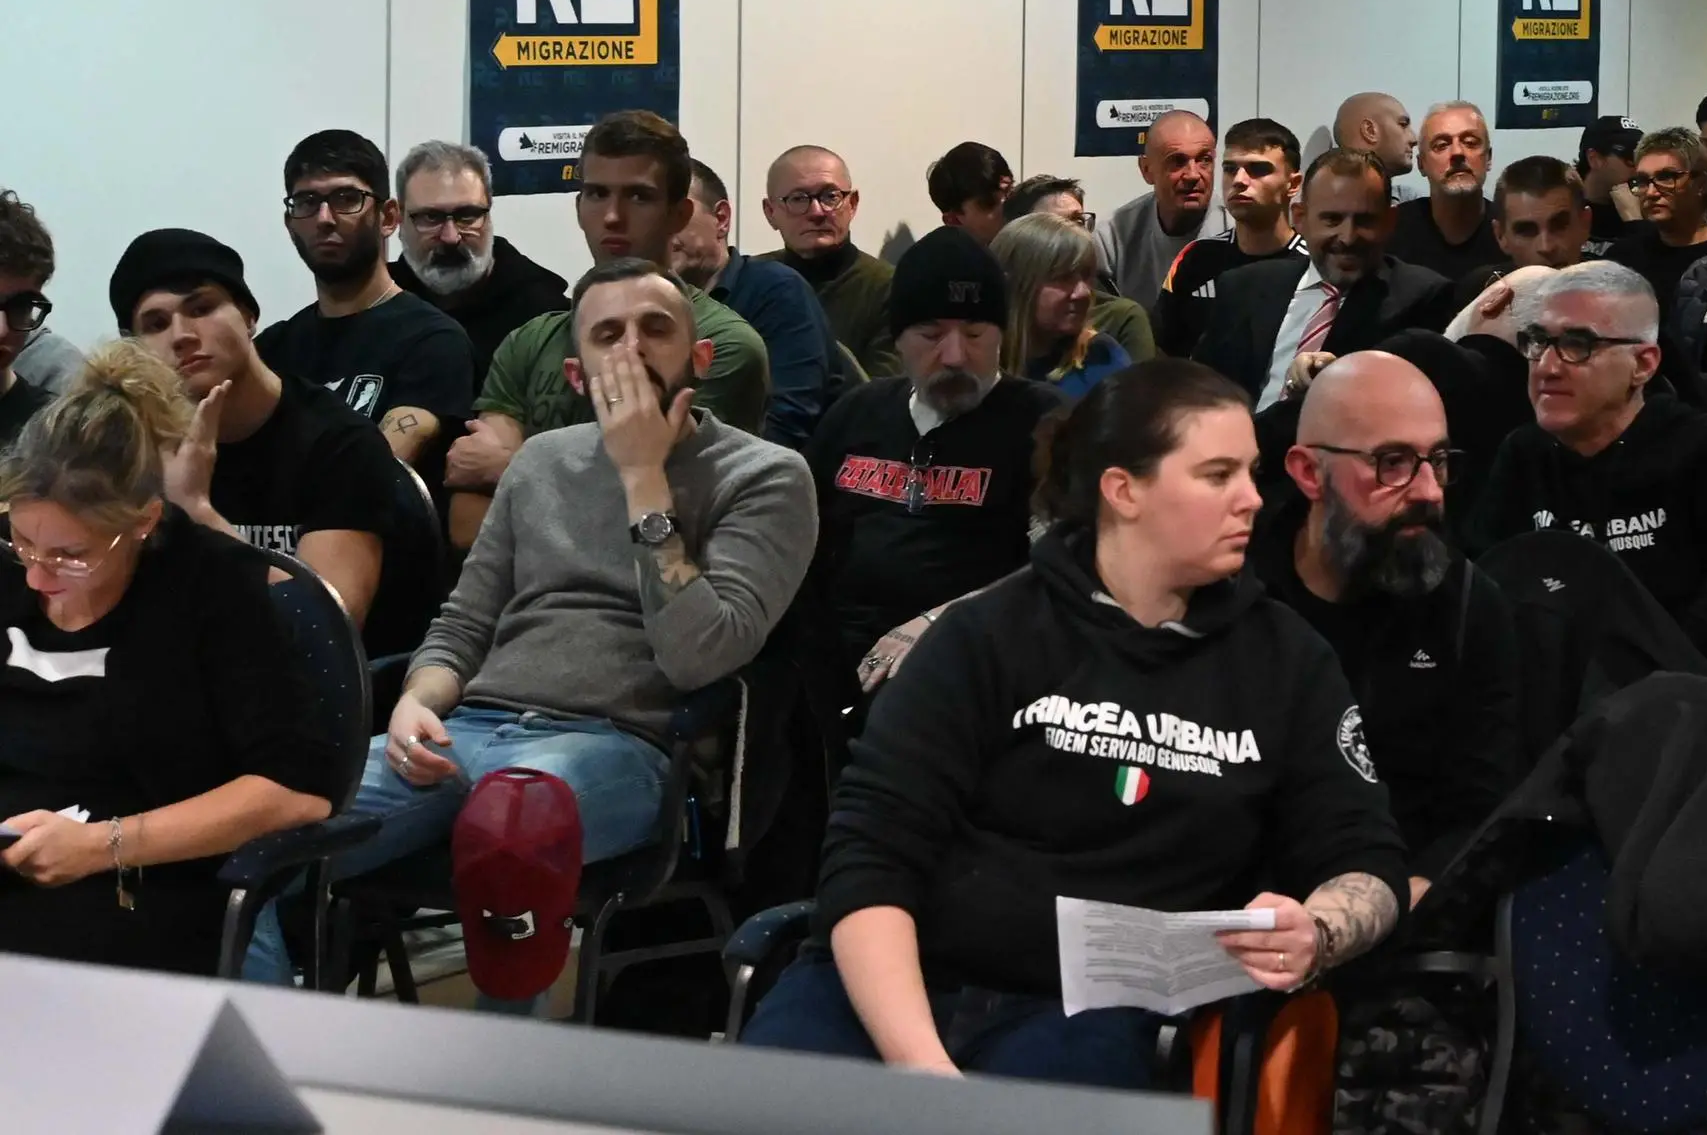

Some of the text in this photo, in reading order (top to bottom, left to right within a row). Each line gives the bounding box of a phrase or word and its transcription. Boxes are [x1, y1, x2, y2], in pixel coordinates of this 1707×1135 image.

[1109, 29, 1188, 46] MIGRAZIONE
[1522, 22, 1579, 36] MIGRAZIONE
[517, 40, 635, 60] MIGRAZIONE
[538, 141, 584, 154] REMIGRA
[1146, 712, 1262, 764] URBANA
[1088, 736, 1156, 766] SERVABO
[1157, 746, 1223, 778] GENUSQUE
